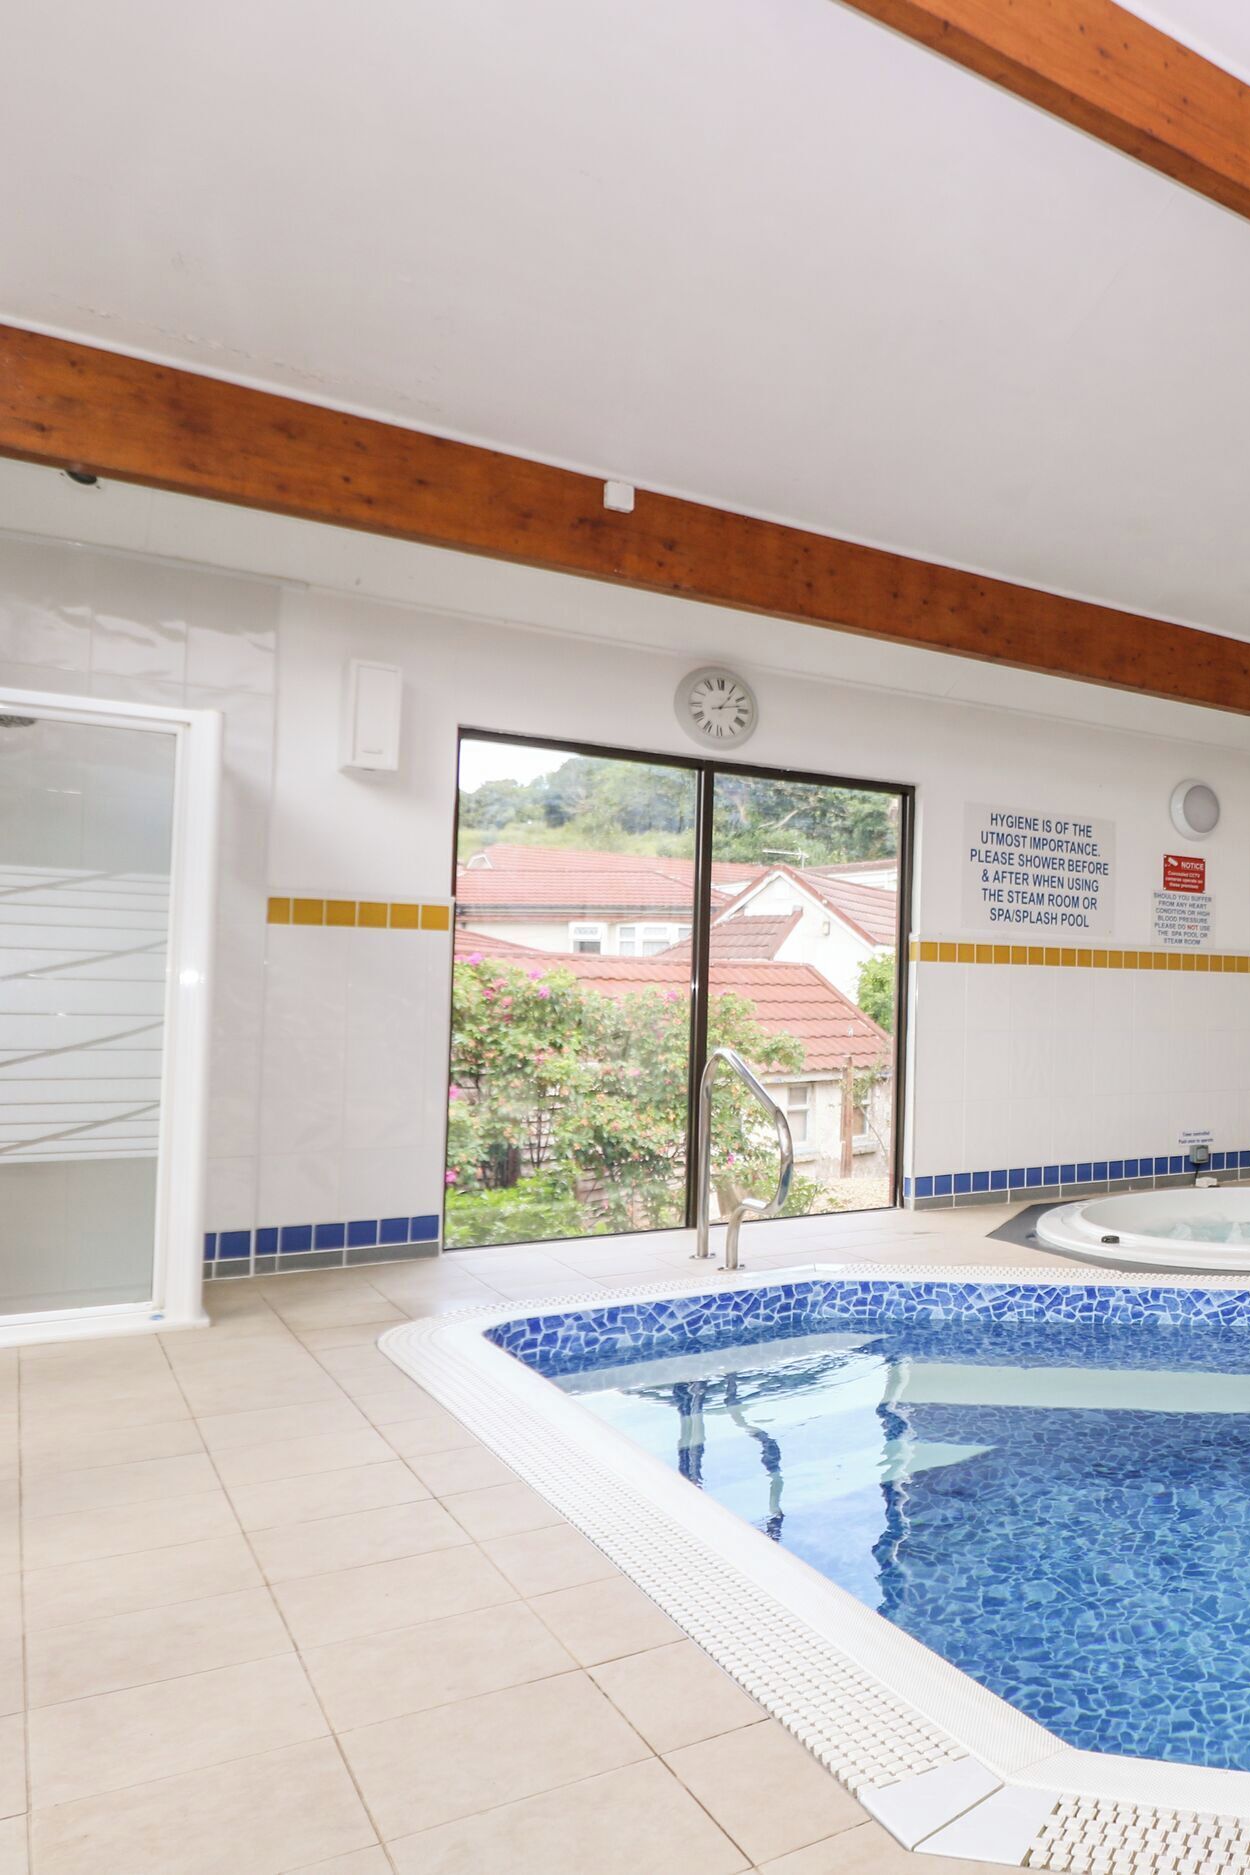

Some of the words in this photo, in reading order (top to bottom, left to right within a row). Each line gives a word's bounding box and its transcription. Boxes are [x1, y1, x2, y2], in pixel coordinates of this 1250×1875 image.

[991, 813, 1039, 831] HYGIENE
[1042, 820, 1052, 833] IS
[1055, 822, 1069, 834] OF
[1073, 824, 1092, 838] THE
[981, 831, 1027, 848] UTMOST
[1030, 837, 1101, 857] IMPORTANCE.
[970, 849, 1014, 866] PLEASE
[1018, 854, 1065, 871] SHOWER
[1068, 860, 1109, 875] BEFORE
[1181, 862, 1204, 870] NOTICE
[982, 869, 989, 882] &
[993, 871, 1029, 886] AFTER
[1032, 874, 1064, 889] WHEN
[1067, 878, 1099, 892] USING
[982, 888, 1004, 902] THE
[1007, 890, 1044, 905] STEAM
[1048, 894, 1079, 908] ROOM
[1082, 897, 1097, 910] OR
[990, 908, 1057, 925] SPA/SPLASH
[1061, 913, 1089, 927] POOL
